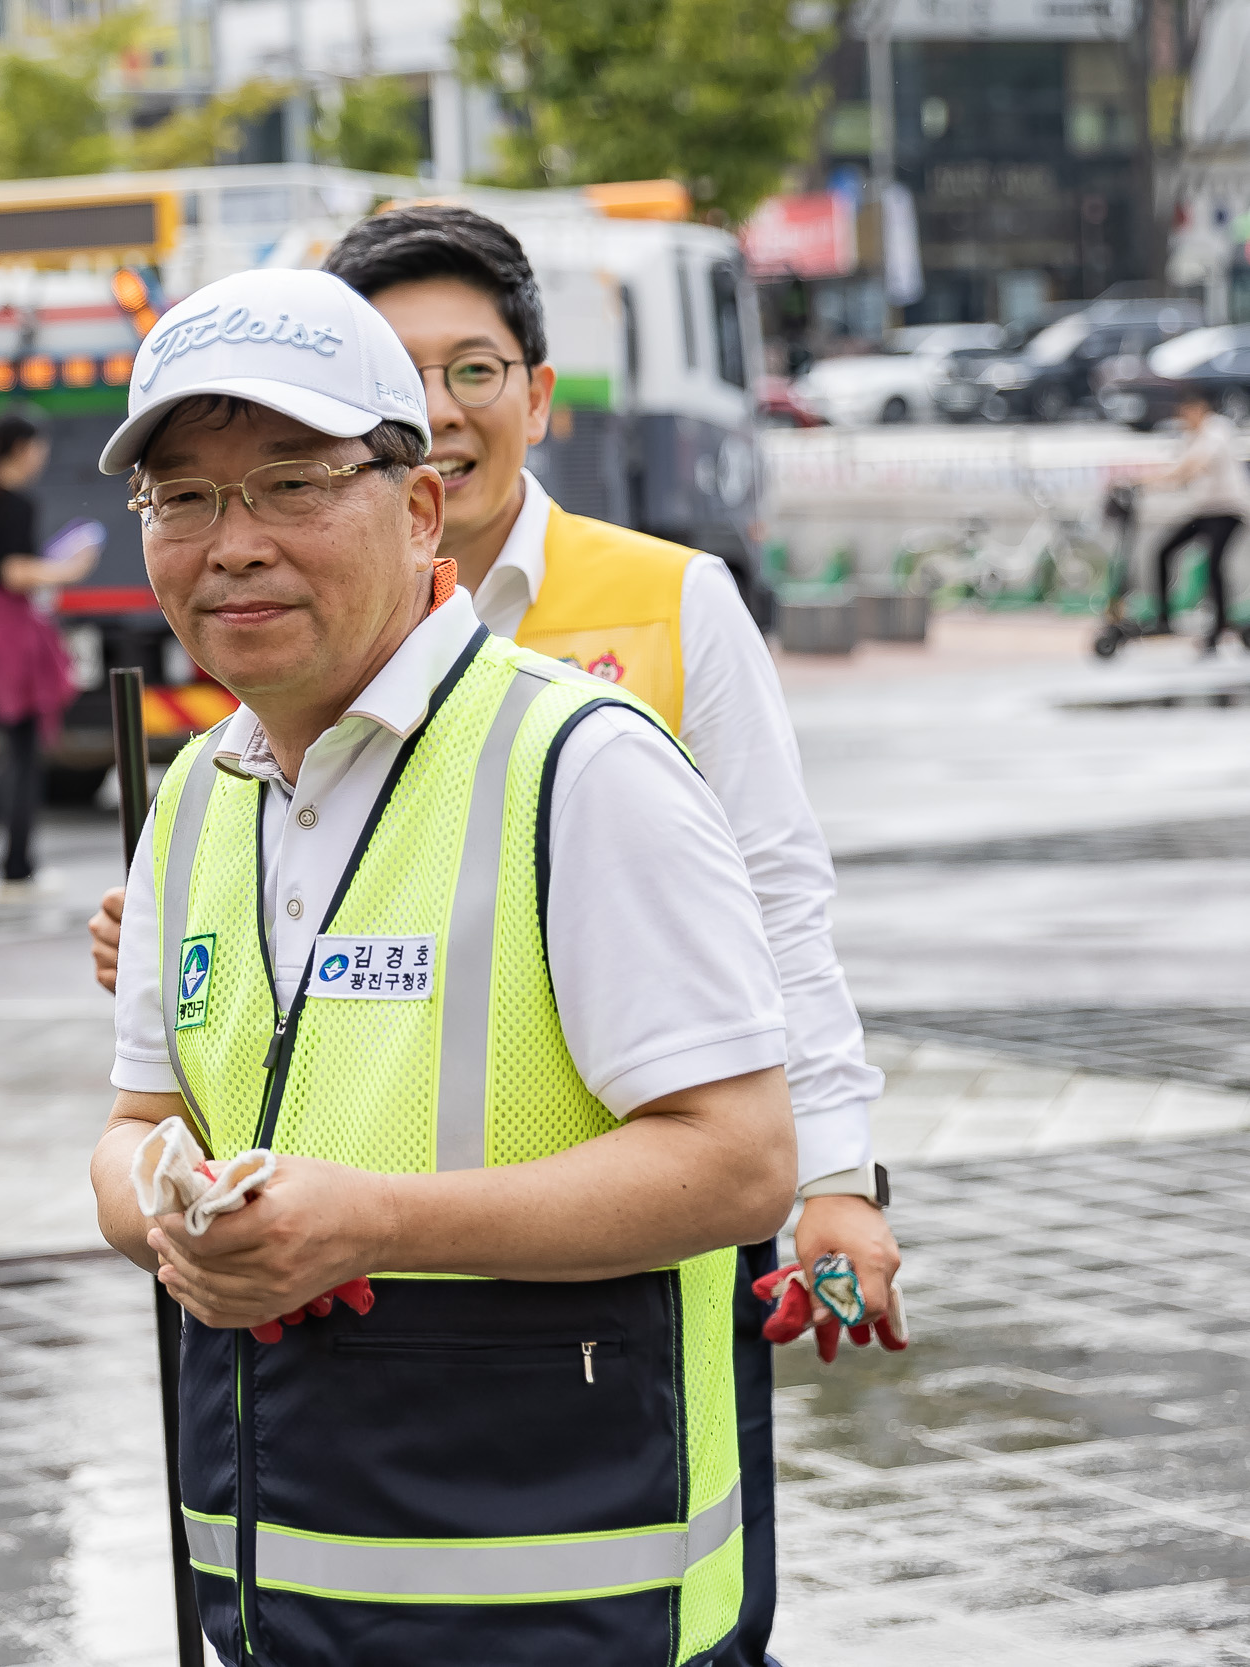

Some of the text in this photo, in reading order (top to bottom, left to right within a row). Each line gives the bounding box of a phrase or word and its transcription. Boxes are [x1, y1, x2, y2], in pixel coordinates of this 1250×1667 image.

[140, 304, 343, 392] Titleist
[350, 971, 428, 991] 광진구청장
[179, 1000, 204, 1021] 광진구
